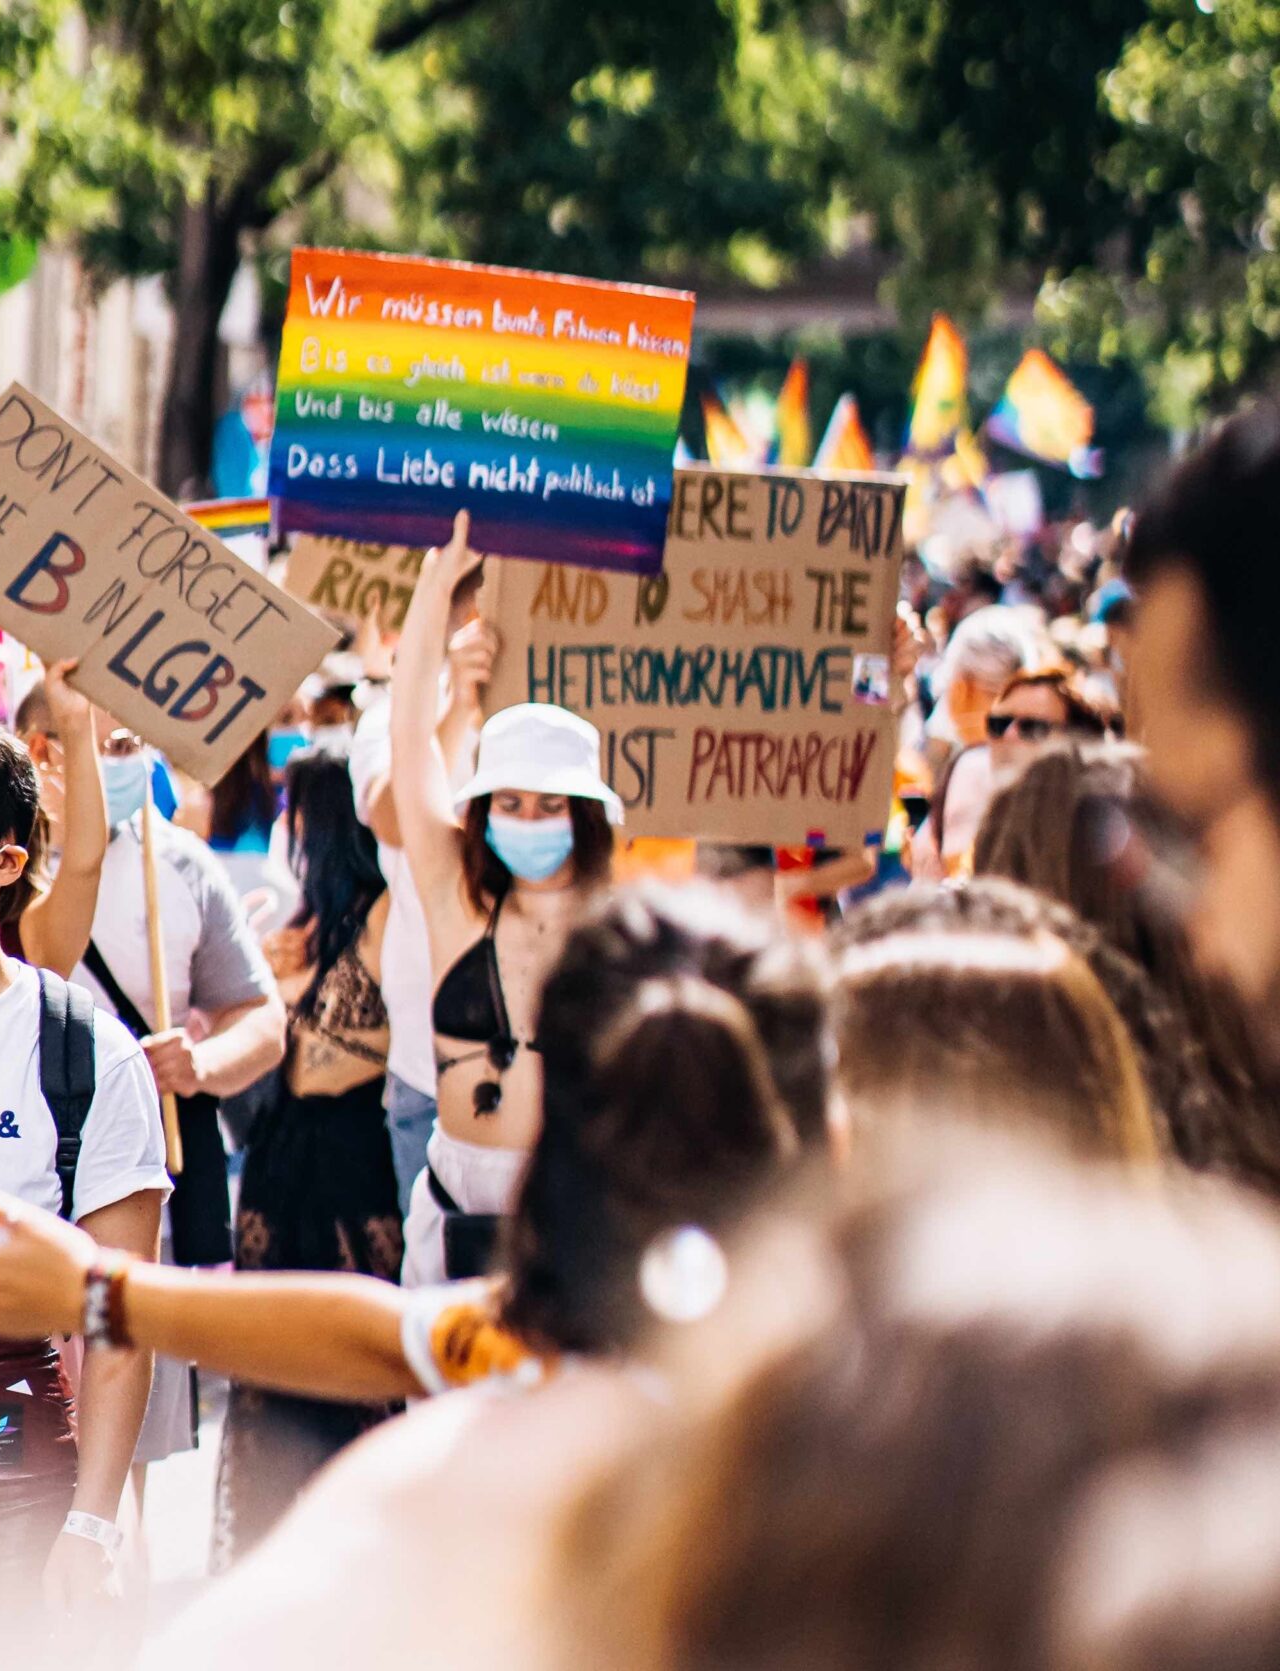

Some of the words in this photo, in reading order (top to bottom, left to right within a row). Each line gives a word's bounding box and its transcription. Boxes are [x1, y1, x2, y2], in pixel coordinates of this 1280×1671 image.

[305, 272, 363, 319] Wir
[380, 292, 485, 329] müssen
[299, 336, 348, 374] Bis
[481, 356, 511, 384] ist
[294, 389, 344, 420] Und
[357, 394, 396, 424] bis
[415, 396, 463, 431] alle
[481, 407, 559, 442] wissen
[286, 443, 358, 480] Dass
[376, 446, 456, 489] Liebe
[468, 454, 540, 494] nicht
[670, 474, 752, 541] ERE
[759, 474, 805, 543] TO
[4, 530, 87, 614] B
[82, 574, 134, 638] IN
[117, 501, 291, 646] FORGET
[529, 563, 610, 626] AND
[681, 566, 794, 626] SMASH
[805, 567, 872, 637] THE
[107, 609, 267, 745] LGBT
[526, 642, 853, 713] HETERONORMATIVE
